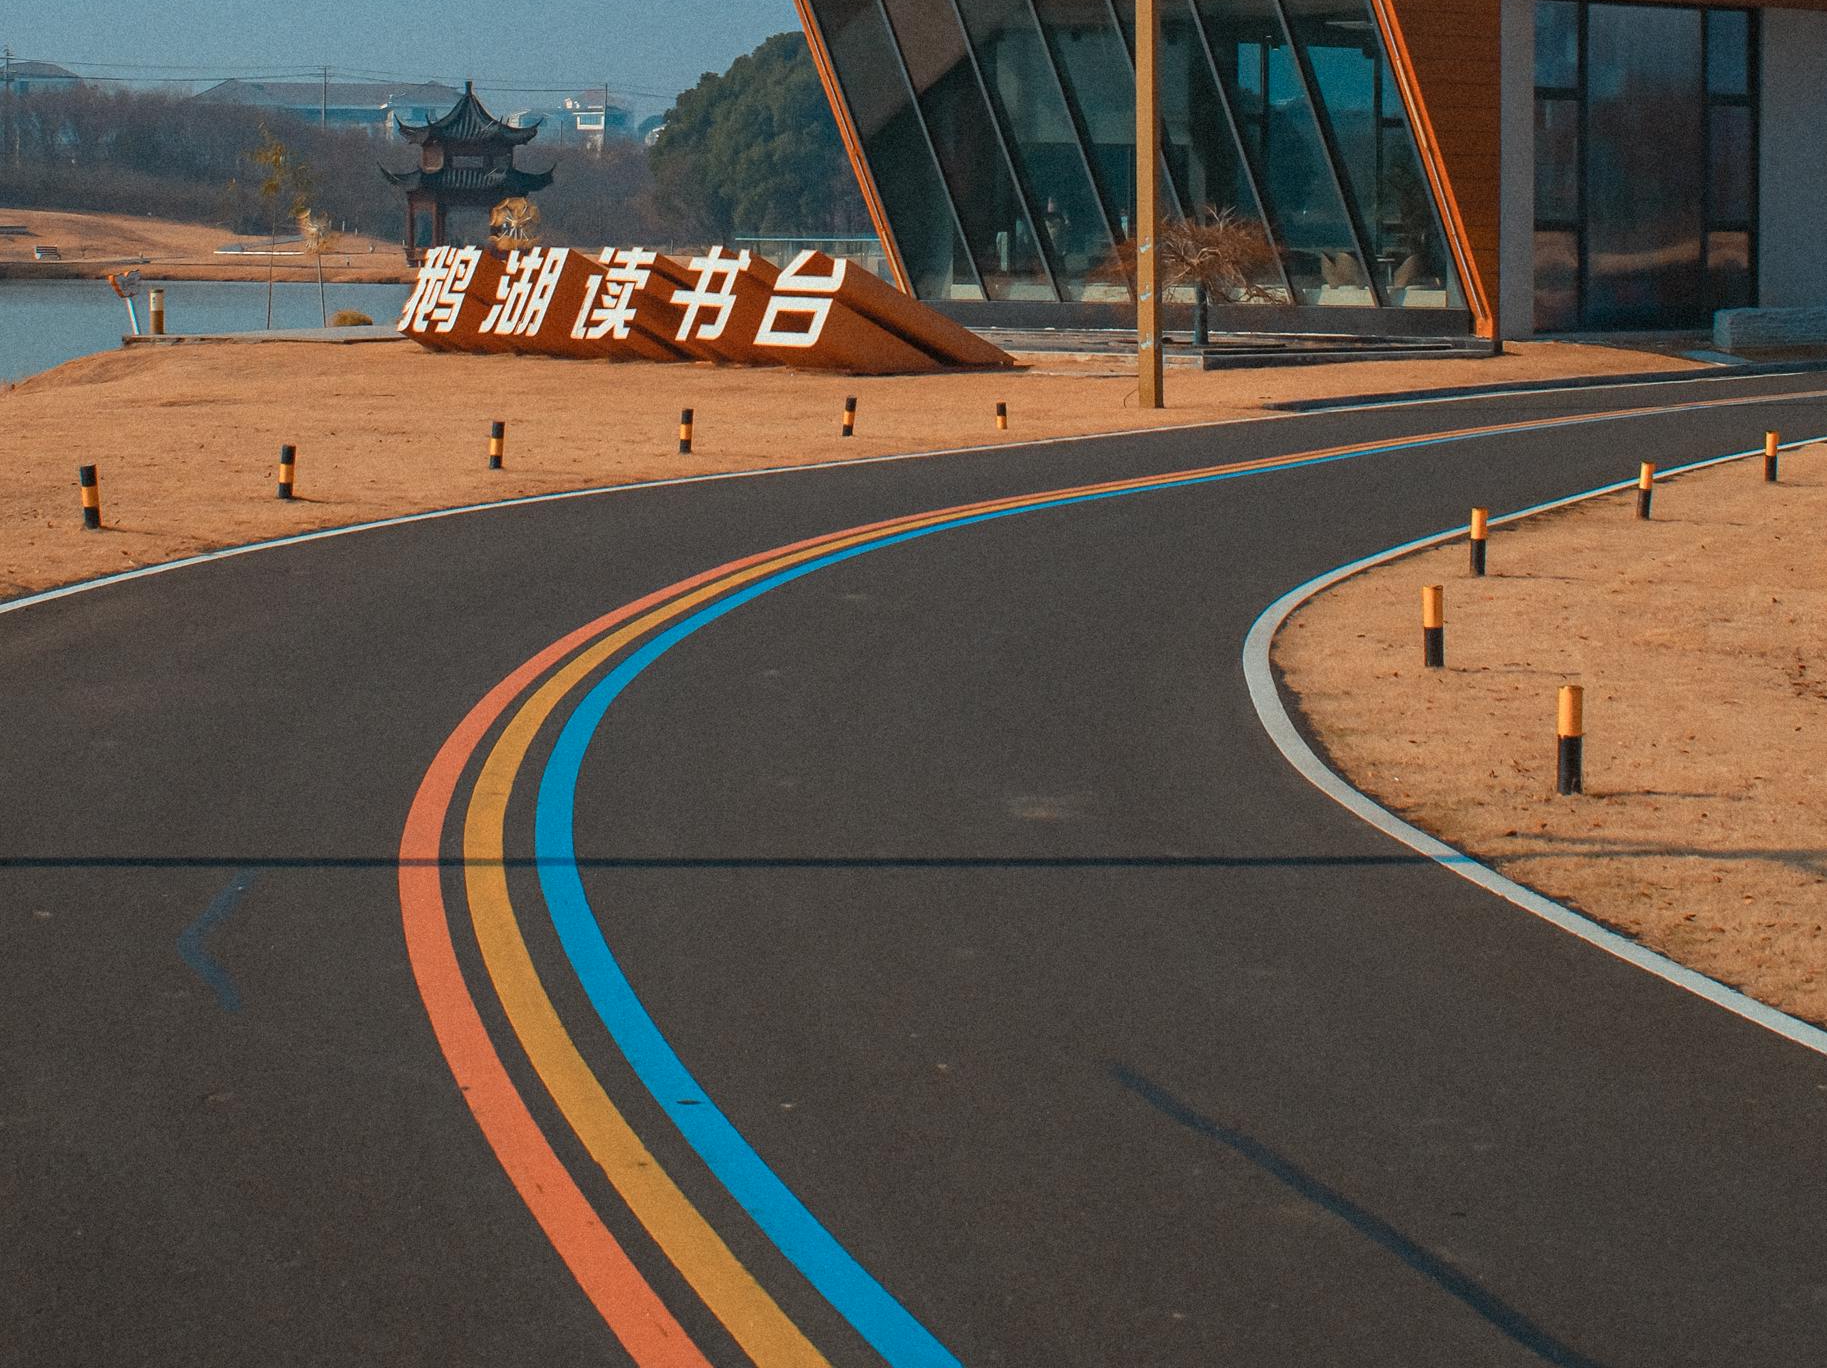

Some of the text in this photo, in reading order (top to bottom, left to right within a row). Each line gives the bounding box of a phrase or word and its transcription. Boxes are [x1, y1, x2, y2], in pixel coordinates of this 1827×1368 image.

[397, 245, 847, 348] 鹅湖读书台
